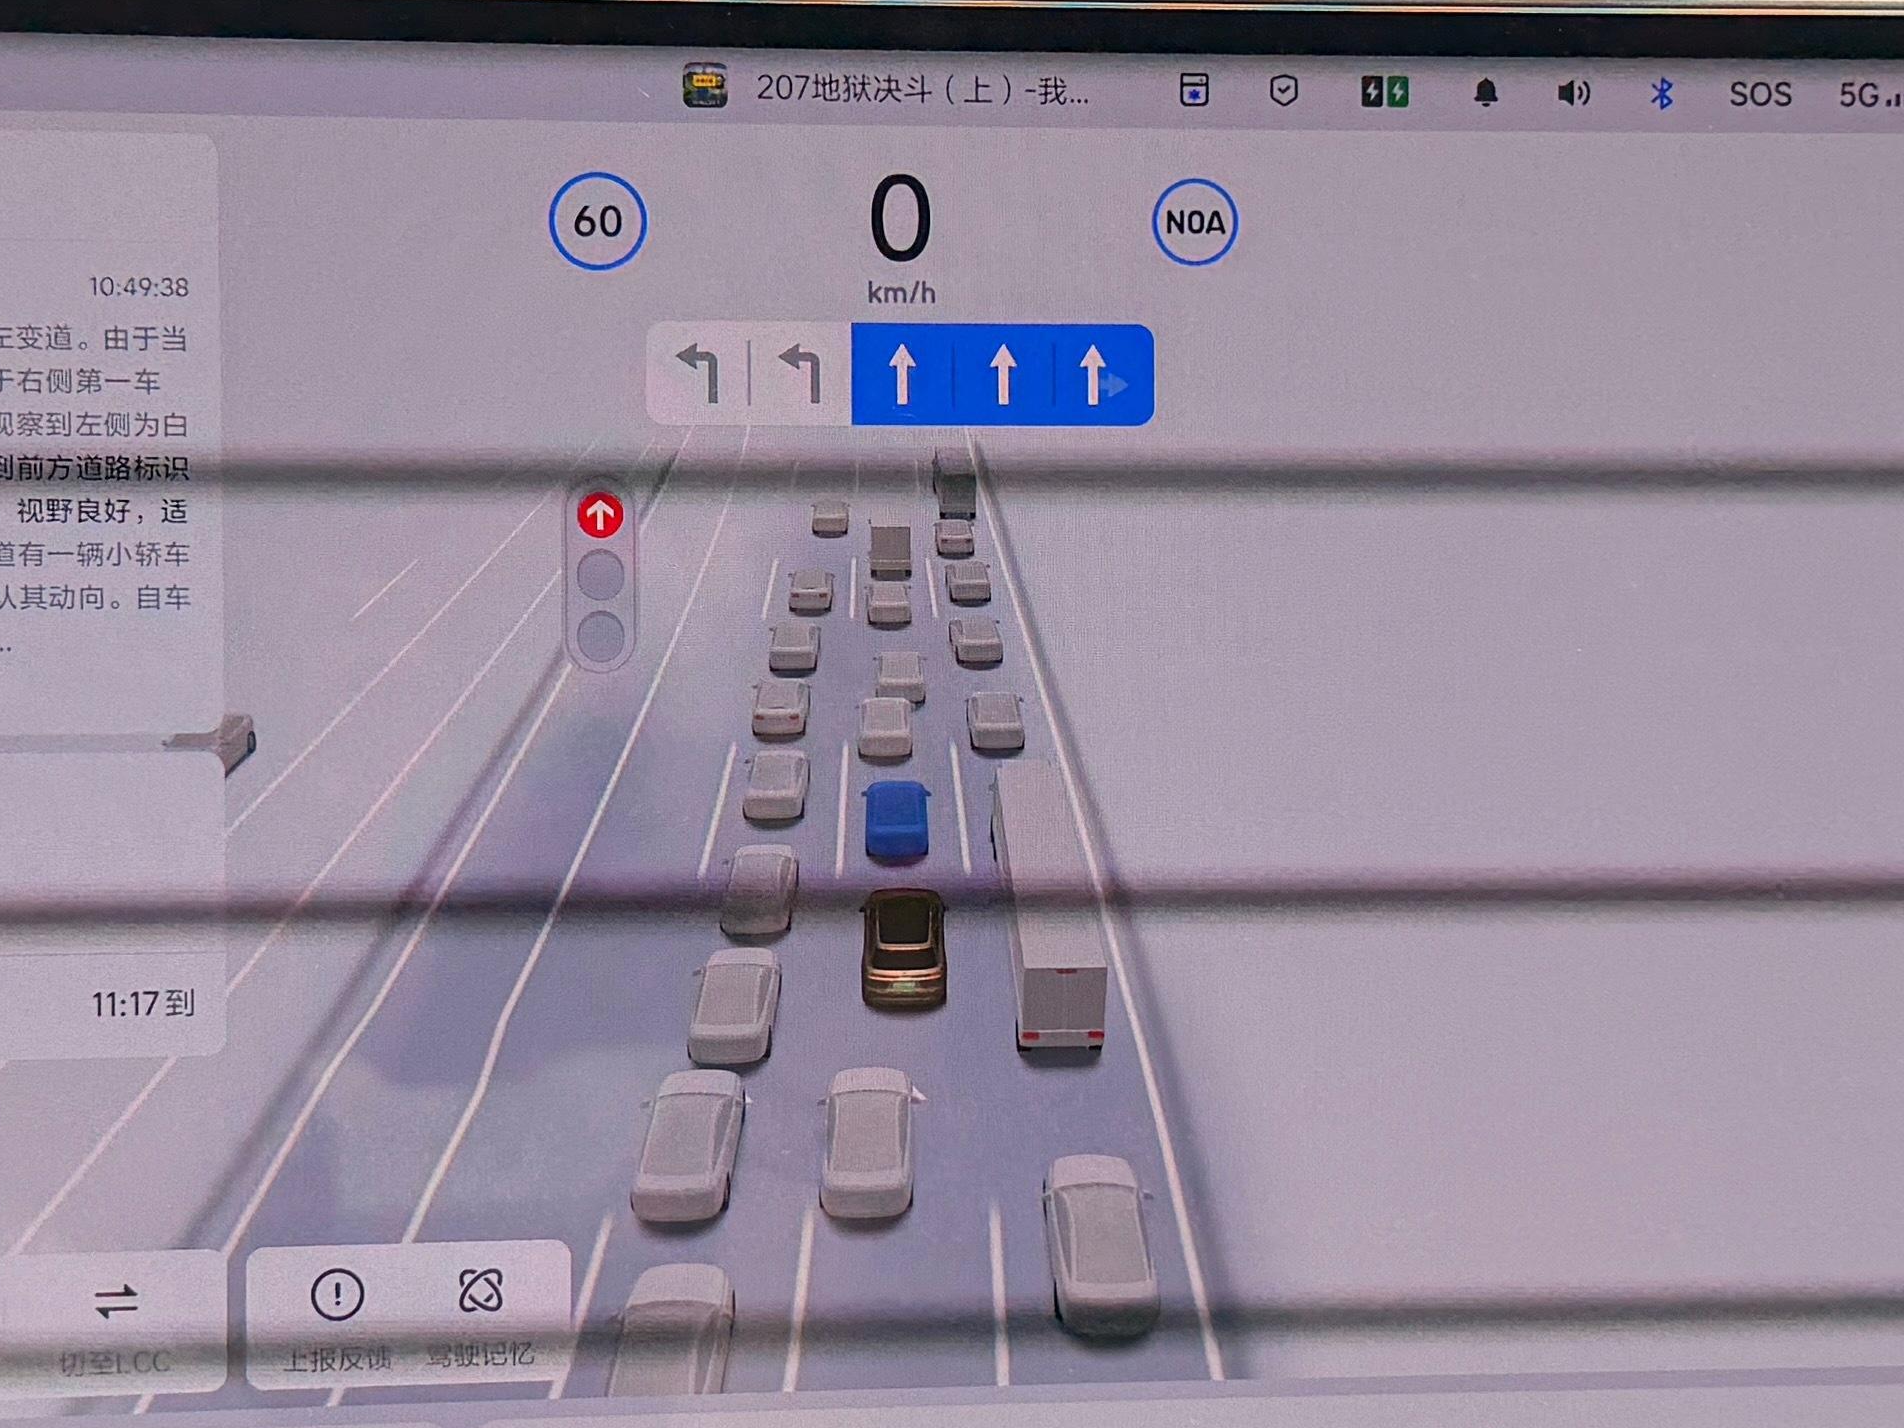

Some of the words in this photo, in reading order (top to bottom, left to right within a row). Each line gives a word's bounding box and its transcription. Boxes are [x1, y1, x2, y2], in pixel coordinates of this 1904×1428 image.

[1730, 82, 1792, 108] SOS
[1839, 82, 1880, 109] 5G
[573, 204, 623, 239] 60
[870, 172, 933, 264] 0
[1165, 209, 1227, 236] NOA
[89, 276, 190, 300] 10:49:38
[867, 278, 937, 306] km/h
[59, 1348, 172, 1376] 切至LCC
[283, 1346, 392, 1373] 上报反馈
[425, 1340, 536, 1369] 驾驶记忆
